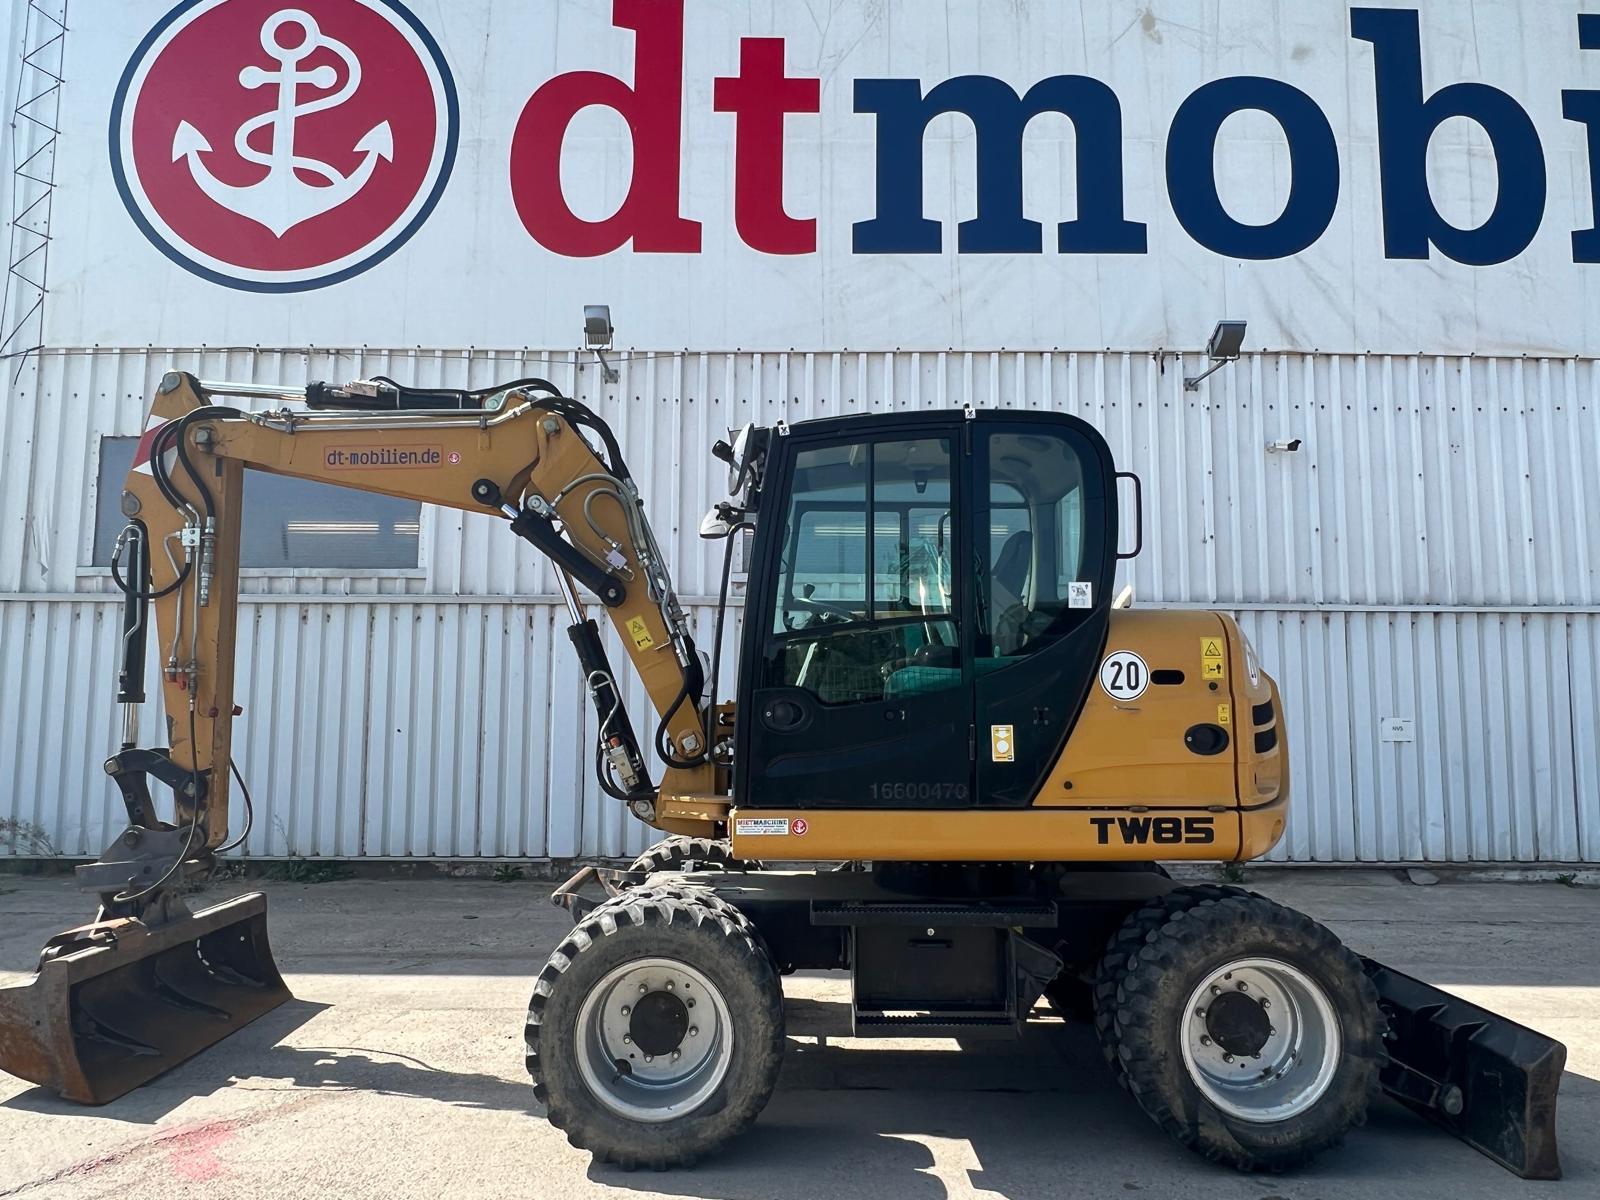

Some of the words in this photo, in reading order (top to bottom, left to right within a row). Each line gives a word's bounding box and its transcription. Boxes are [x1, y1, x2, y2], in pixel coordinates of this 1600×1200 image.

[327, 448, 440, 465] dt-mobilien.de
[1109, 661, 1139, 691] 20
[1089, 817, 1215, 844] TW85
